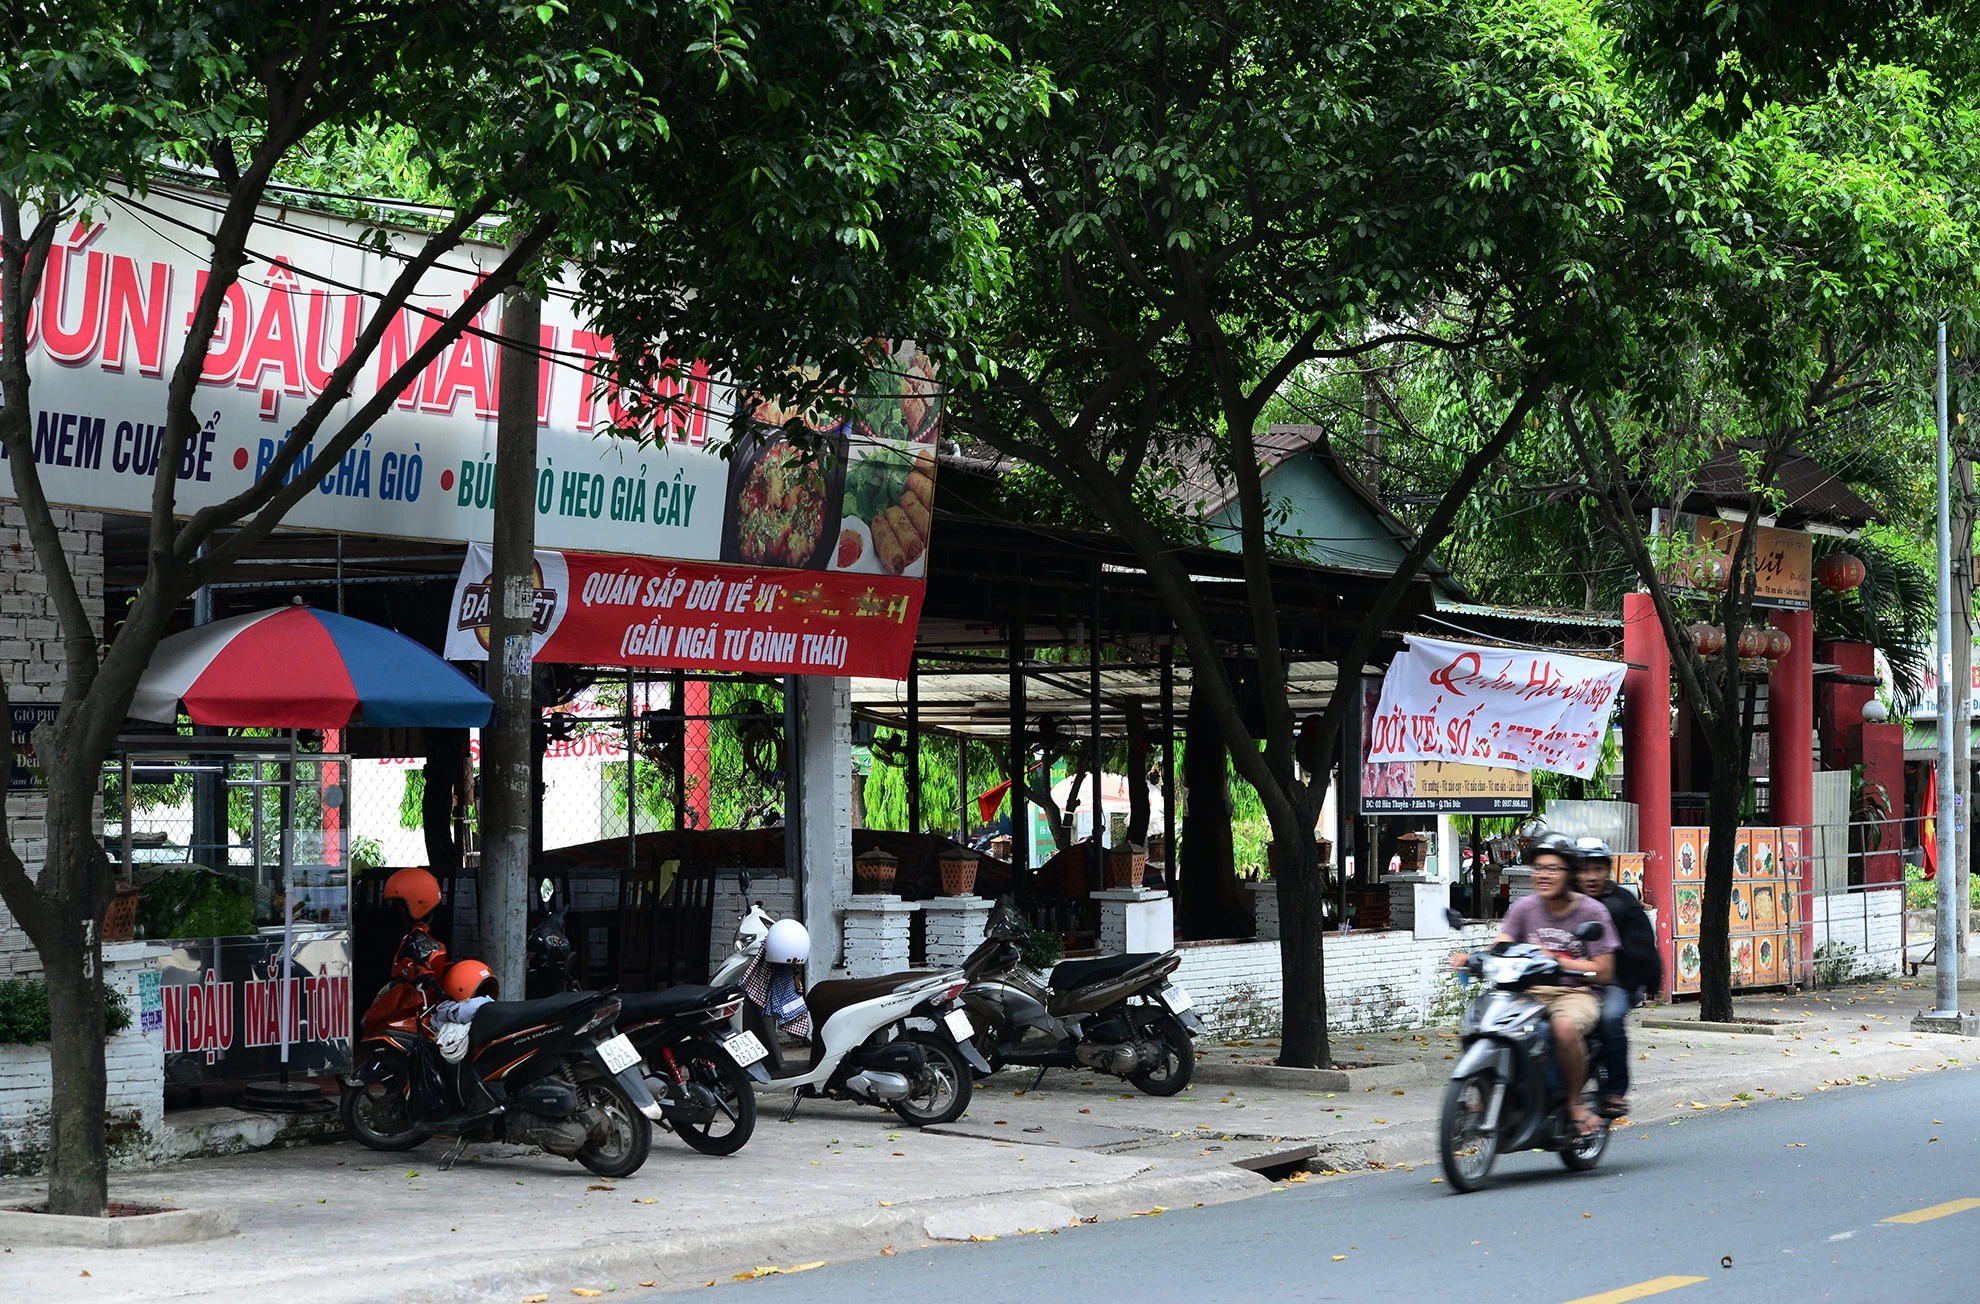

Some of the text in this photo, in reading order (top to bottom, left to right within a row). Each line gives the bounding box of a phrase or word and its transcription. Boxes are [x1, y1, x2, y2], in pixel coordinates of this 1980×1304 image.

[35, 411, 106, 470] NEM
[379, 442, 423, 503] GIÒ
[559, 470, 605, 519] HEO
[610, 463, 646, 523] GIẢ
[653, 467, 697, 528] CẦY
[582, 568, 643, 607] QUÁN
[642, 567, 686, 609] SẮP
[724, 575, 757, 614] VỀ
[620, 614, 848, 669] (GẦN NGÃ TƯ BÌNH THÁI)
[1430, 652, 1516, 697] Quán
[1515, 660, 1564, 701] Hà
[1446, 702, 1485, 756] SỐ
[187, 967, 234, 1066] ĐẬU
[244, 953, 300, 1048] MẮM
[304, 962, 350, 1043] TÔM
